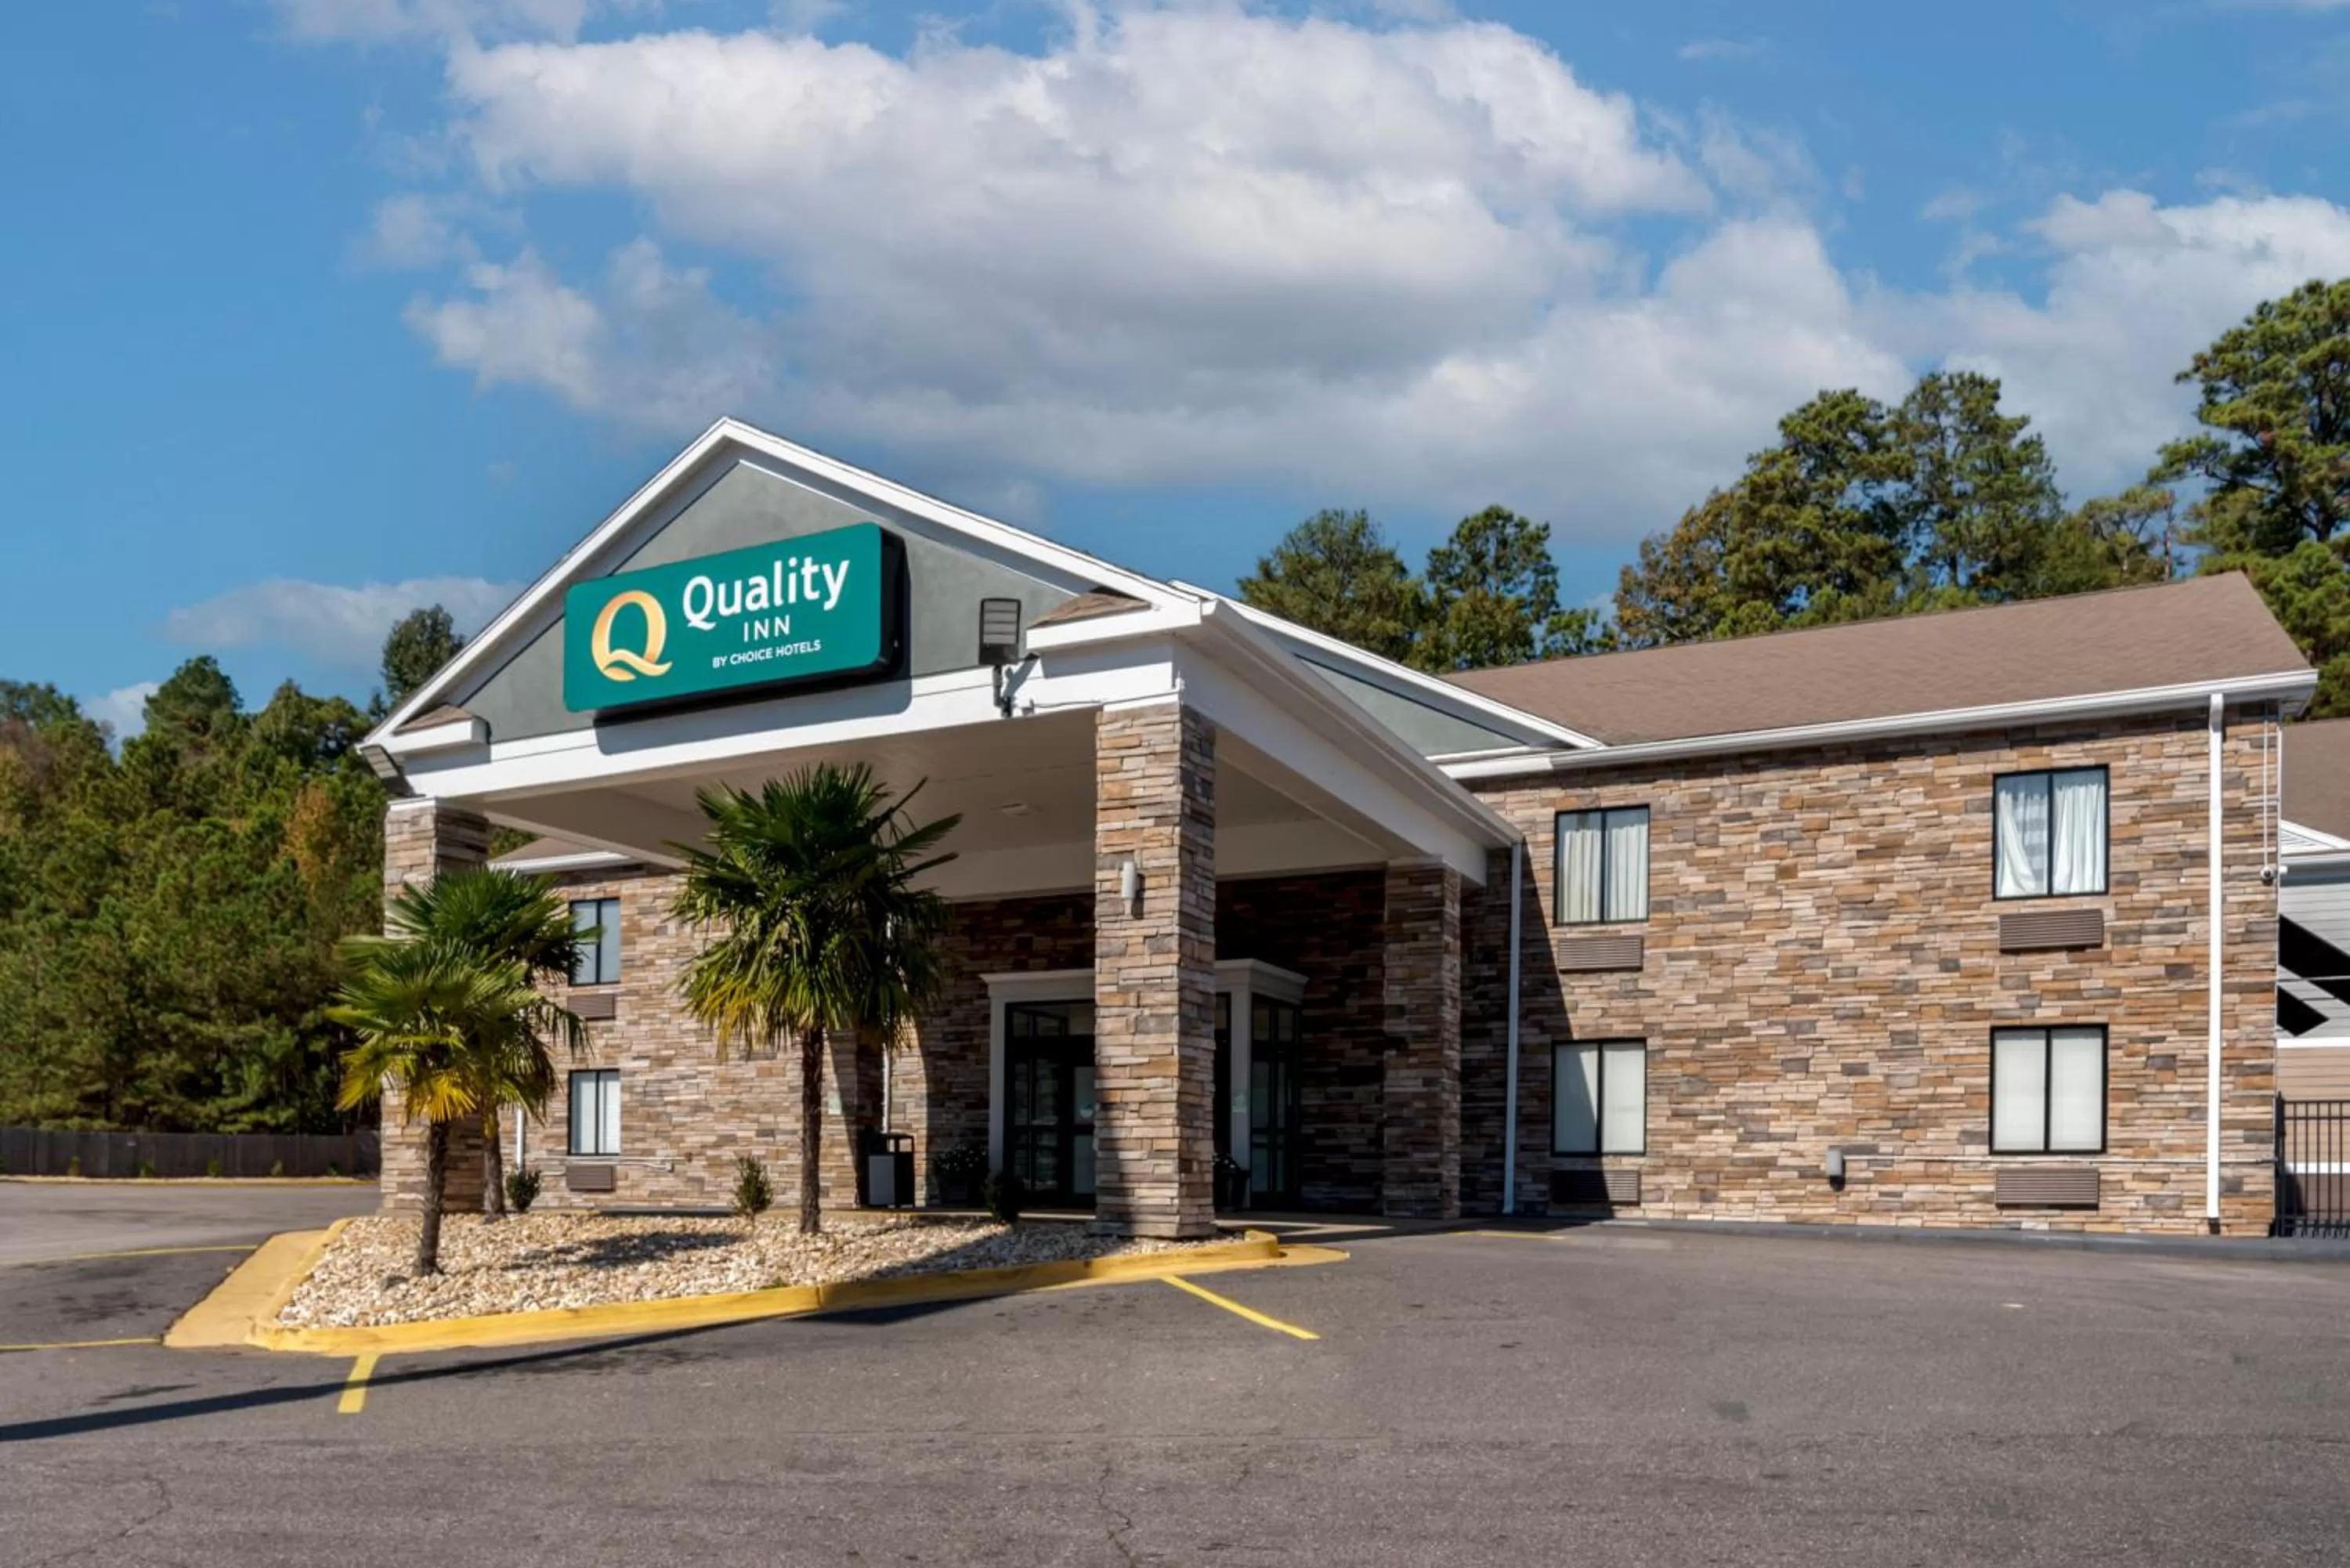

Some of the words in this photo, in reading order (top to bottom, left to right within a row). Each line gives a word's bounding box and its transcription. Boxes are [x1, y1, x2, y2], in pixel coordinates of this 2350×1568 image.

[682, 556, 850, 630] Quality
[591, 590, 673, 681] Q
[712, 655, 728, 668] BY
[729, 647, 773, 665] CHOICE
[775, 639, 822, 657] HOTELS
[743, 614, 790, 642] INN
